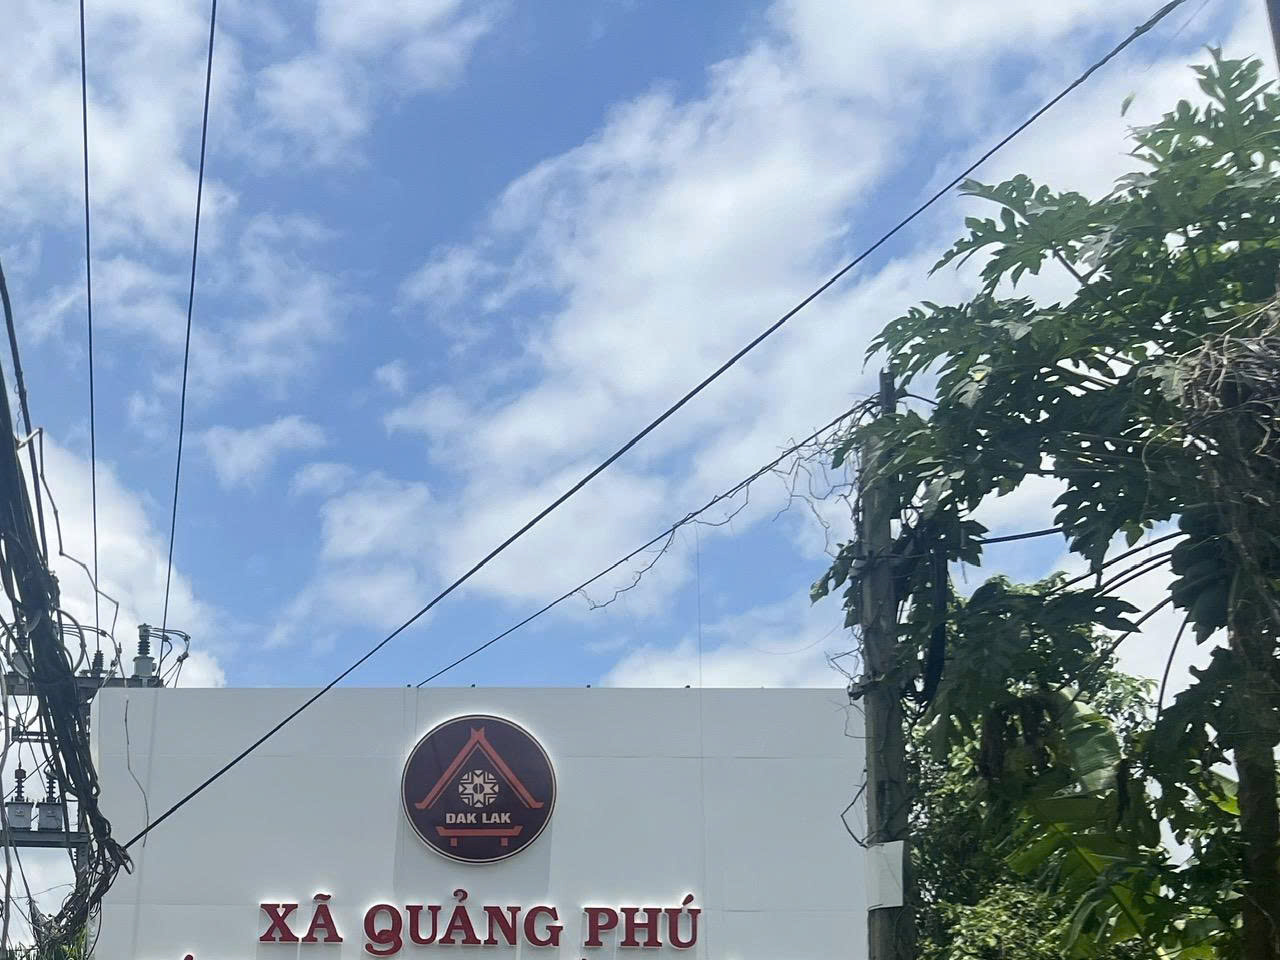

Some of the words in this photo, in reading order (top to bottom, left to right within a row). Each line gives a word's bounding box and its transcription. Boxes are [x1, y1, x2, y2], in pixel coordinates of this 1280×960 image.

[482, 813, 511, 823] LAK
[259, 893, 343, 943] XÃ
[363, 889, 563, 956] QUẢNG
[584, 895, 701, 948] PHÚ
